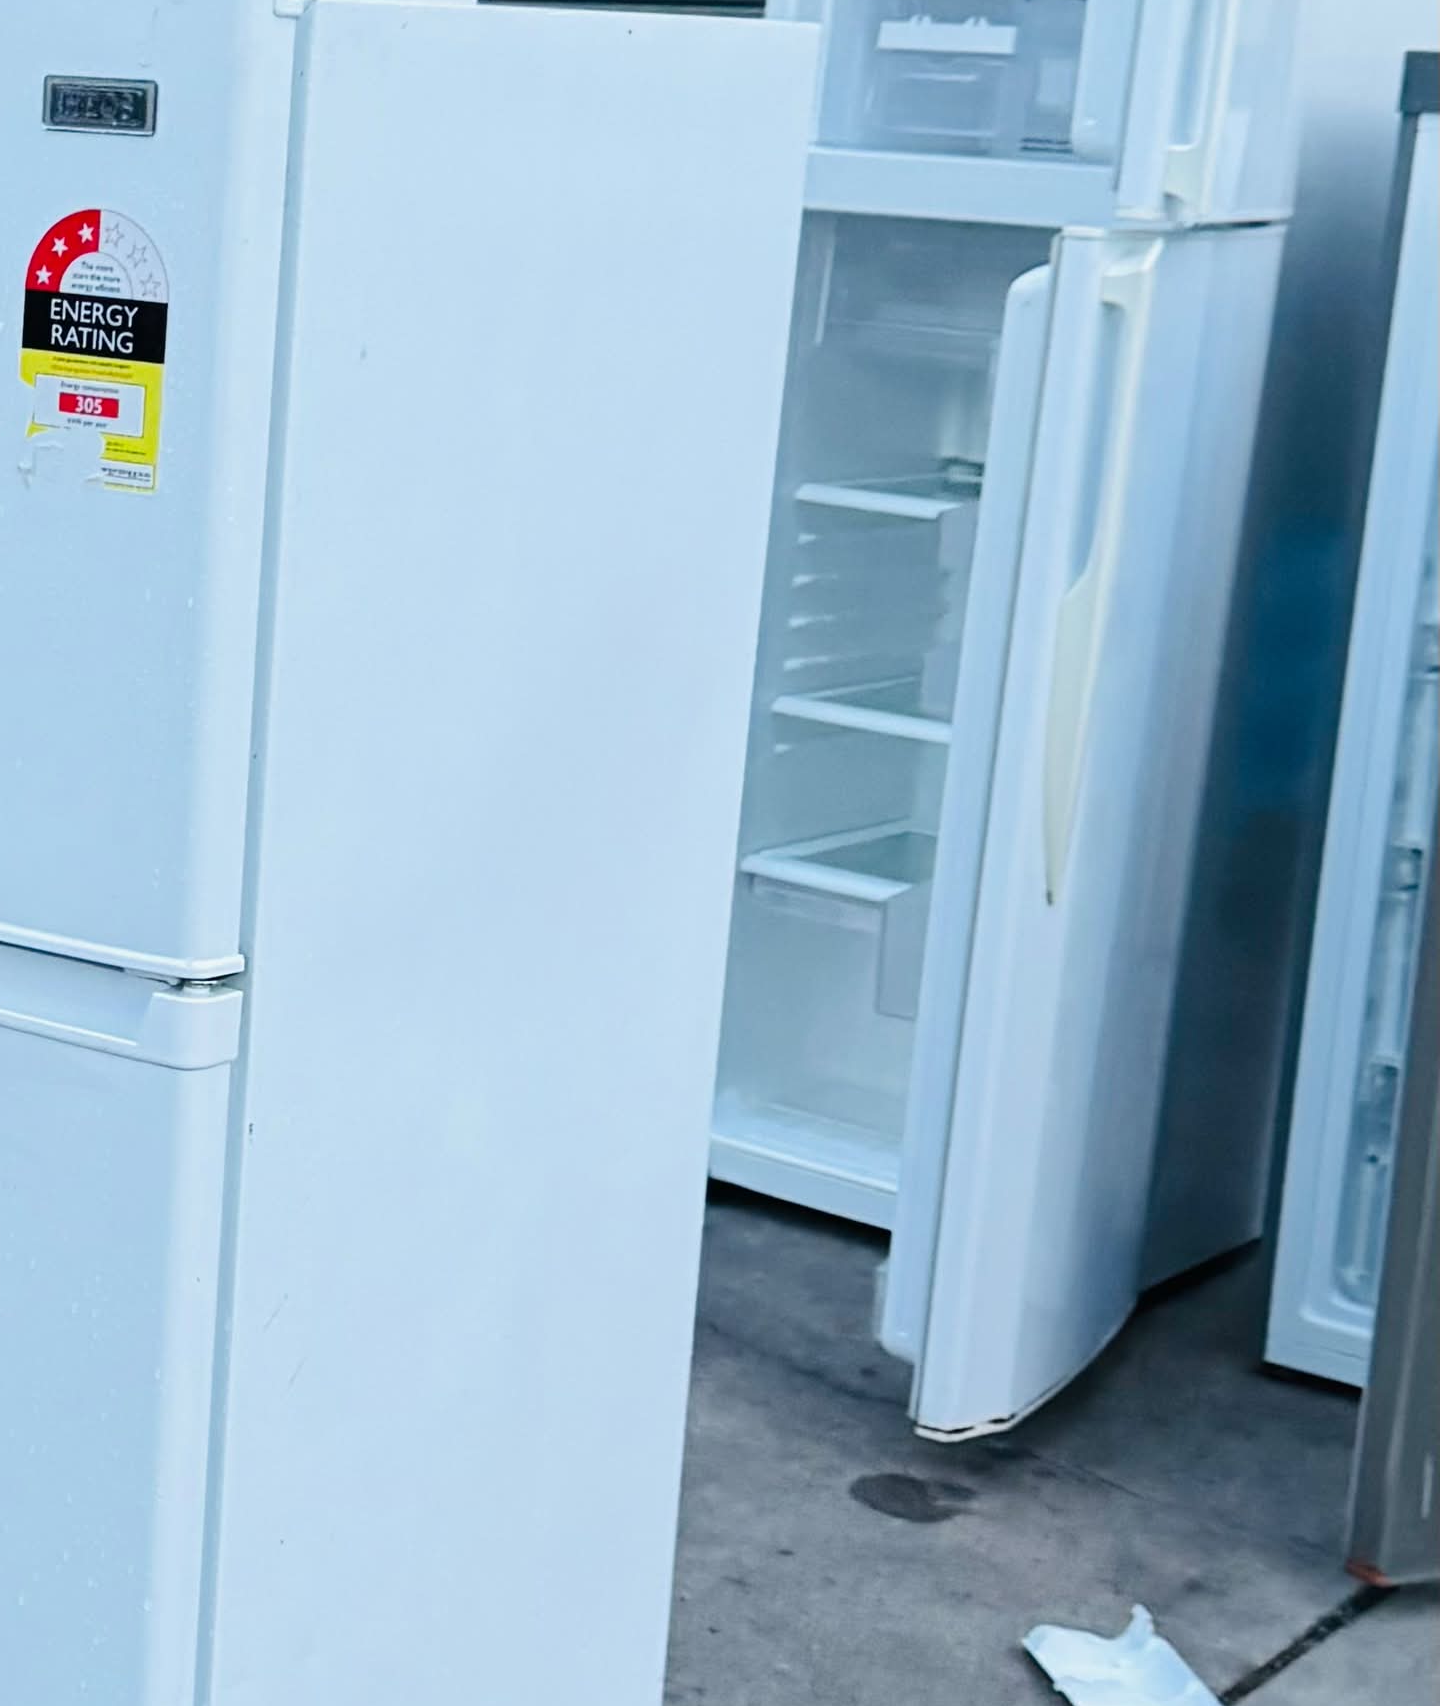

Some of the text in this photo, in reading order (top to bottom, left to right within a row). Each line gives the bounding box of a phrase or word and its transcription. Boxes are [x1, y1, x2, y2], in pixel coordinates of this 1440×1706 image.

[50, 298, 139, 328] ENERGY
[50, 323, 134, 354] RATING
[74, 395, 103, 415] 305
